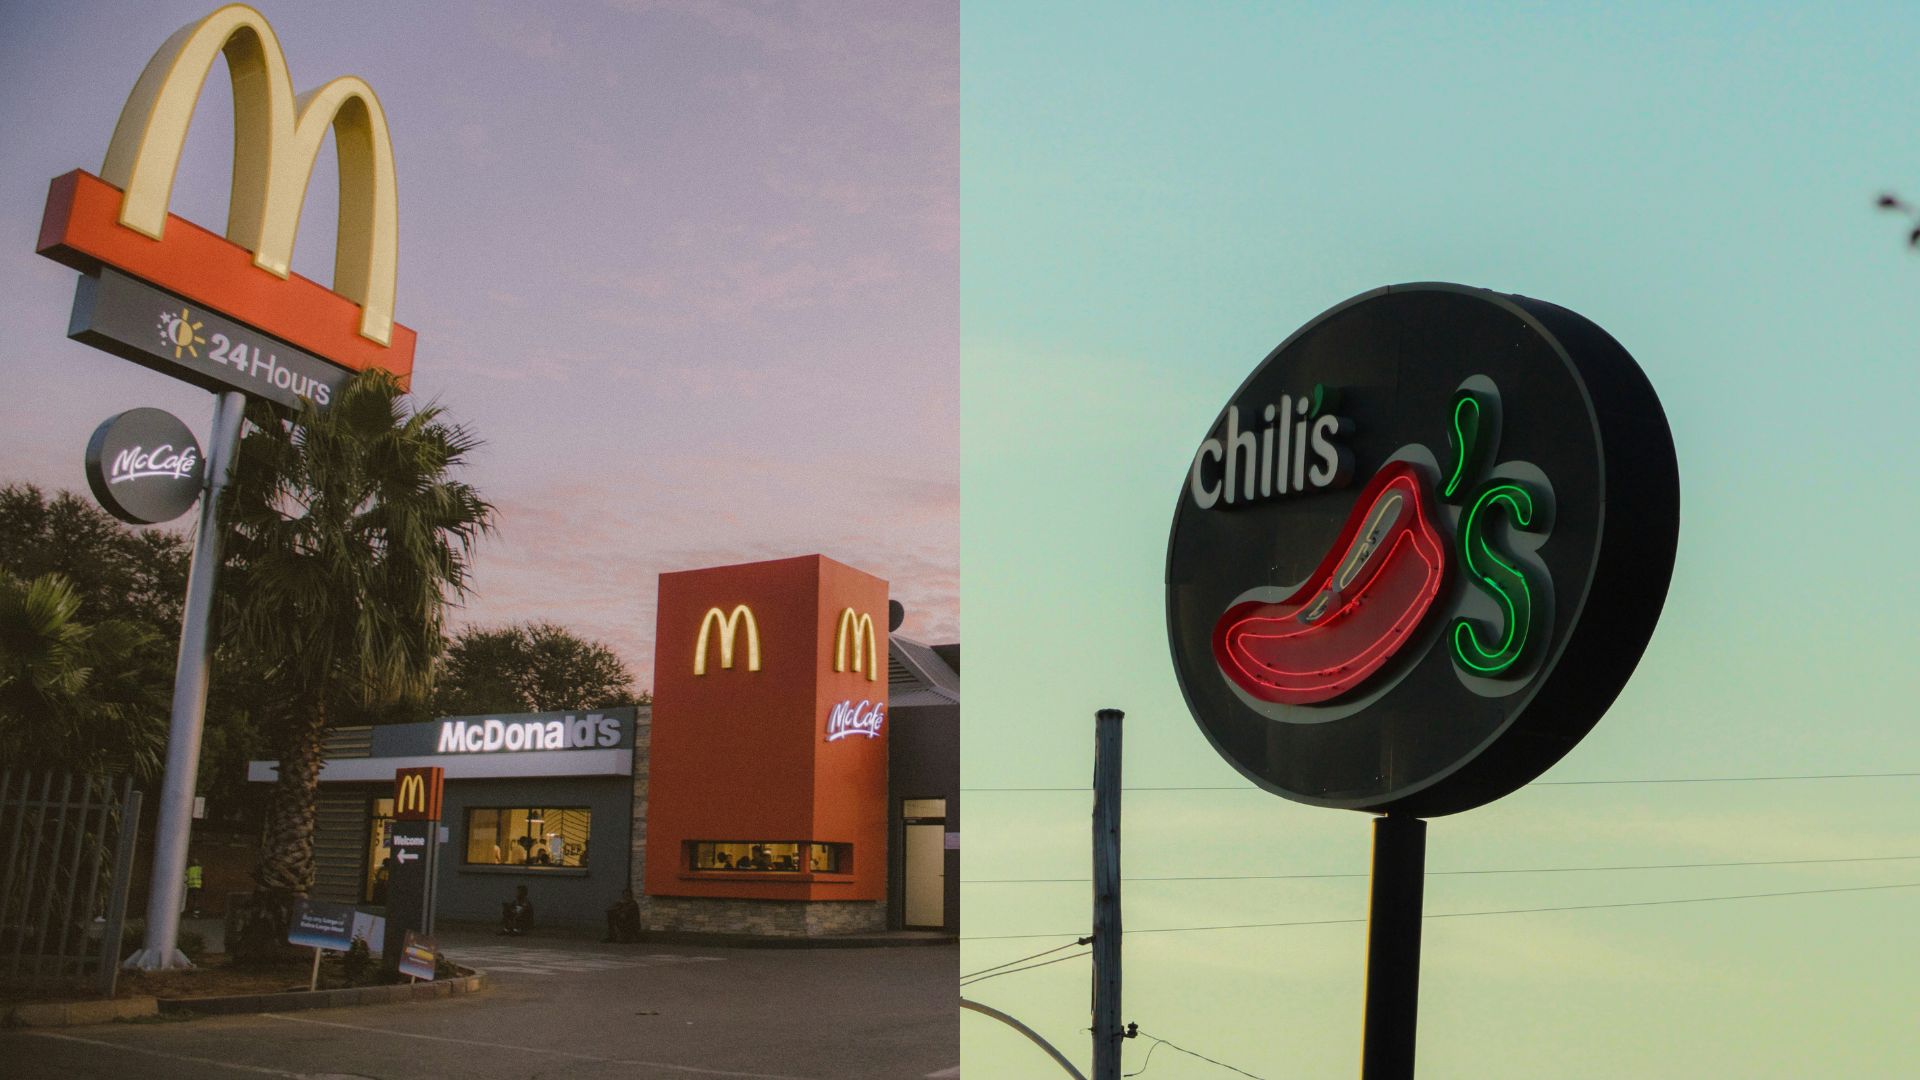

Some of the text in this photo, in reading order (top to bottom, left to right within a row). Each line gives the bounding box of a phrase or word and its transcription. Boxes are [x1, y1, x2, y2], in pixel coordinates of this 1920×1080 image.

[103, 3, 398, 348] M
[208, 333, 331, 405] 24 Hours
[111, 444, 196, 483] McCafé
[1191, 383, 1339, 509] chili's
[694, 604, 762, 675] M
[834, 607, 877, 681] M
[438, 714, 622, 752] McDonald's
[827, 699, 885, 741] McCafé
[398, 774, 425, 813] M
[394, 835, 425, 846] Welcome
